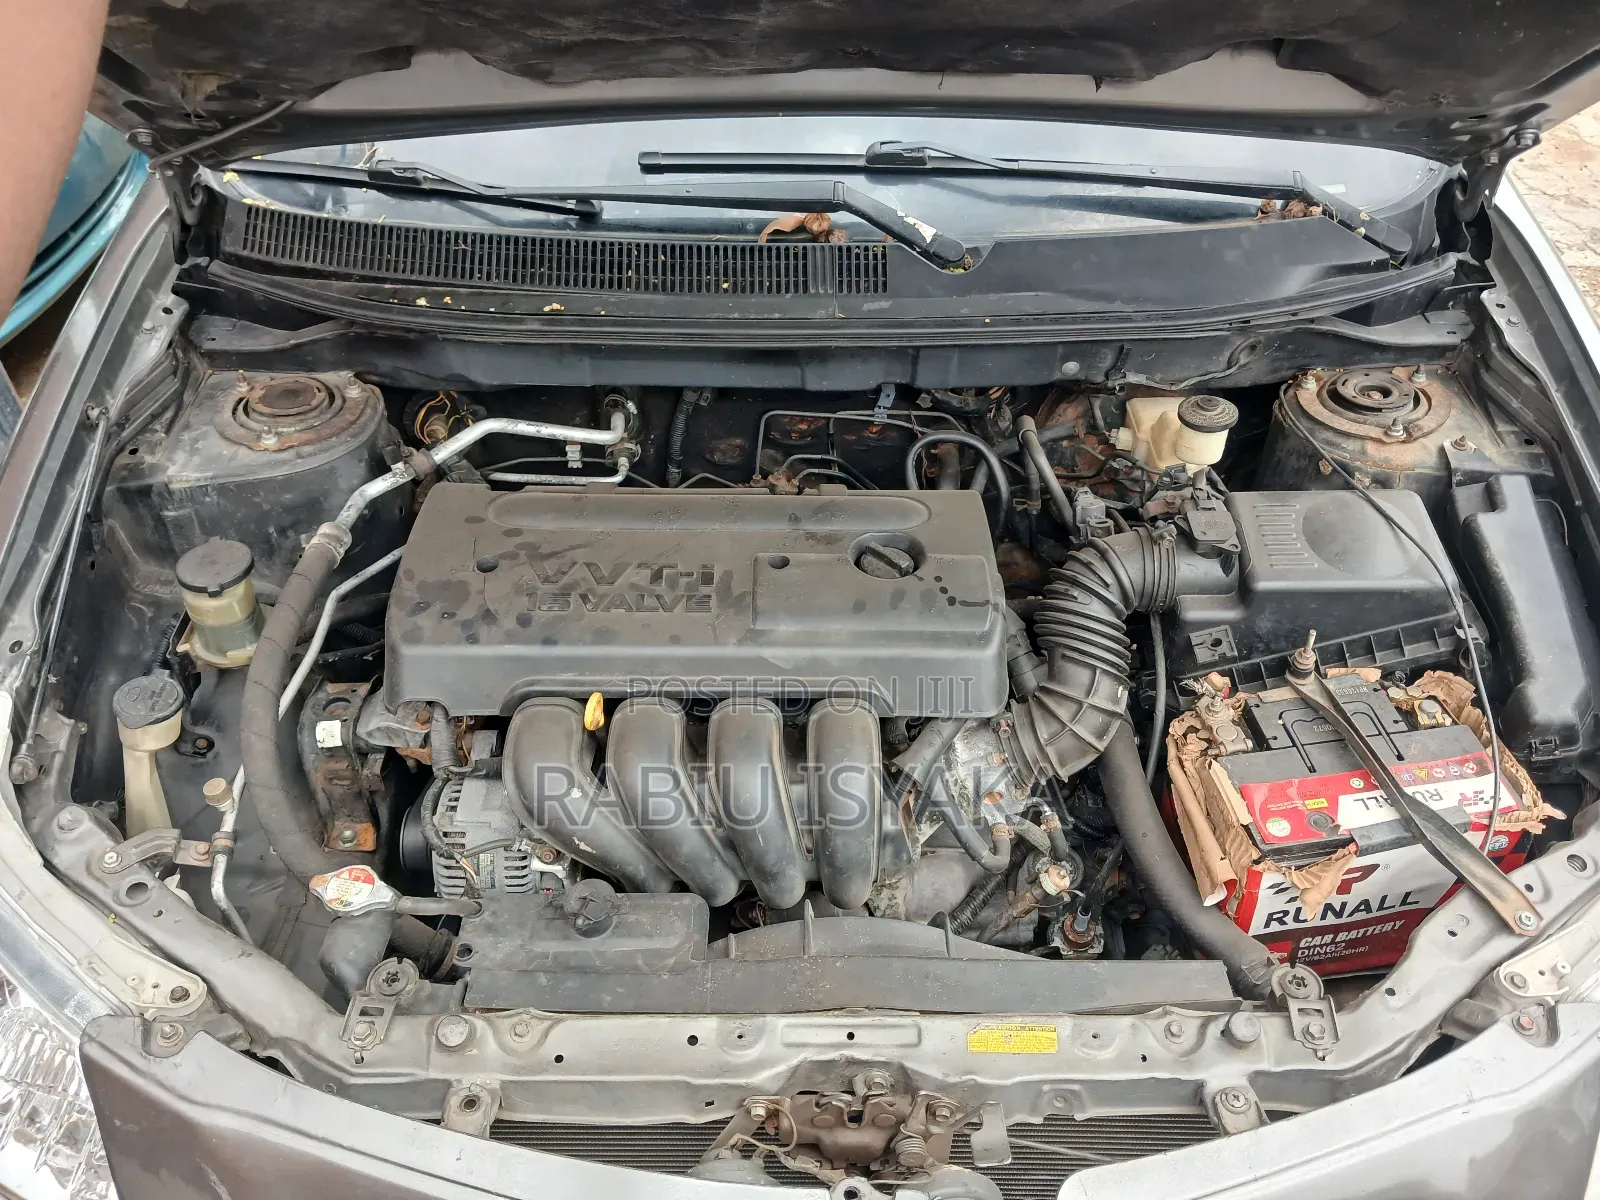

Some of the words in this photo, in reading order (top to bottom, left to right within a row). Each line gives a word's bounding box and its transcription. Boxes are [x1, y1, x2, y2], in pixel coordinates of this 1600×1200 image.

[525, 592, 572, 612] 16
[577, 592, 713, 613] VALVE
[1312, 724, 1336, 733] 0572
[1352, 788, 1444, 811] RUALL
[1299, 934, 1334, 948] CAR
[1335, 919, 1406, 942] BATTERY
[1297, 942, 1346, 958] DIN62
